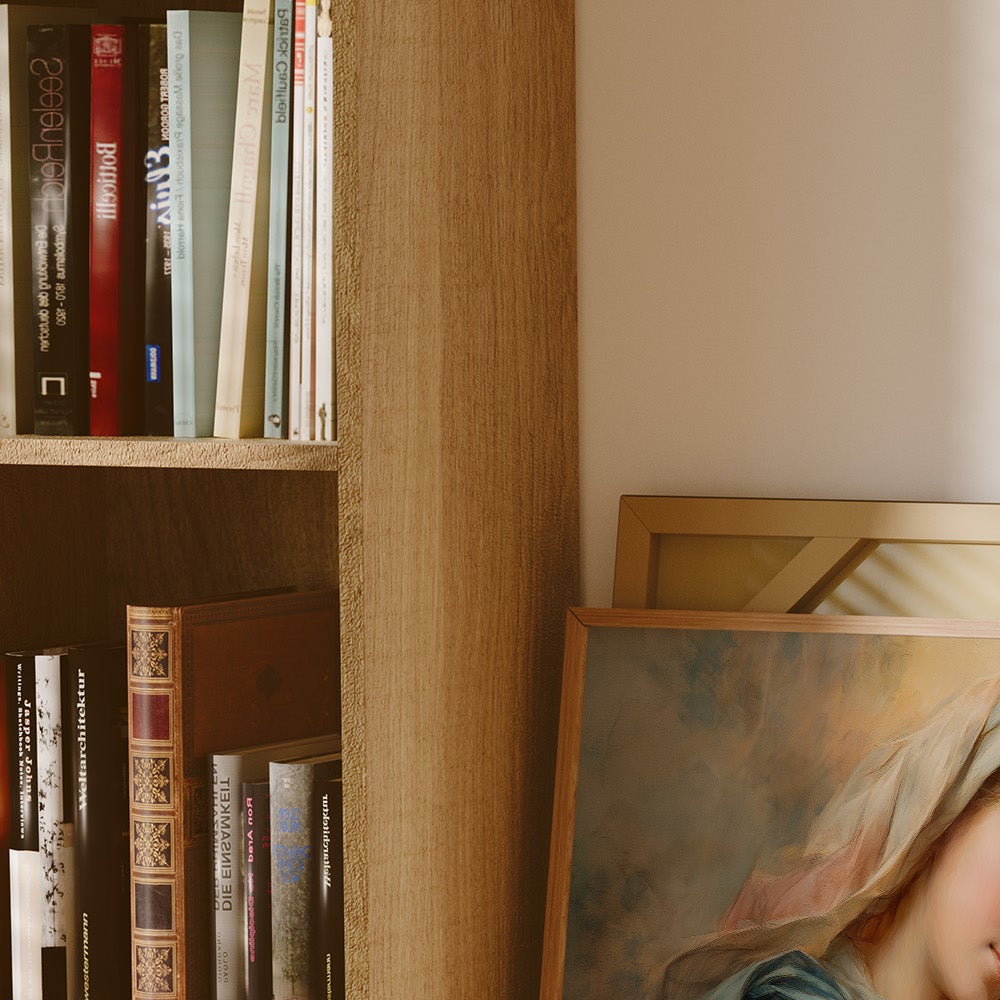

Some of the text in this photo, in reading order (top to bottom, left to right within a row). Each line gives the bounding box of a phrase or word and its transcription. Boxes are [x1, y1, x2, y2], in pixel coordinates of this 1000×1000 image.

[22, 700, 33, 803] Jasper Johns
[77, 668, 88, 811] Weltarchitektur
